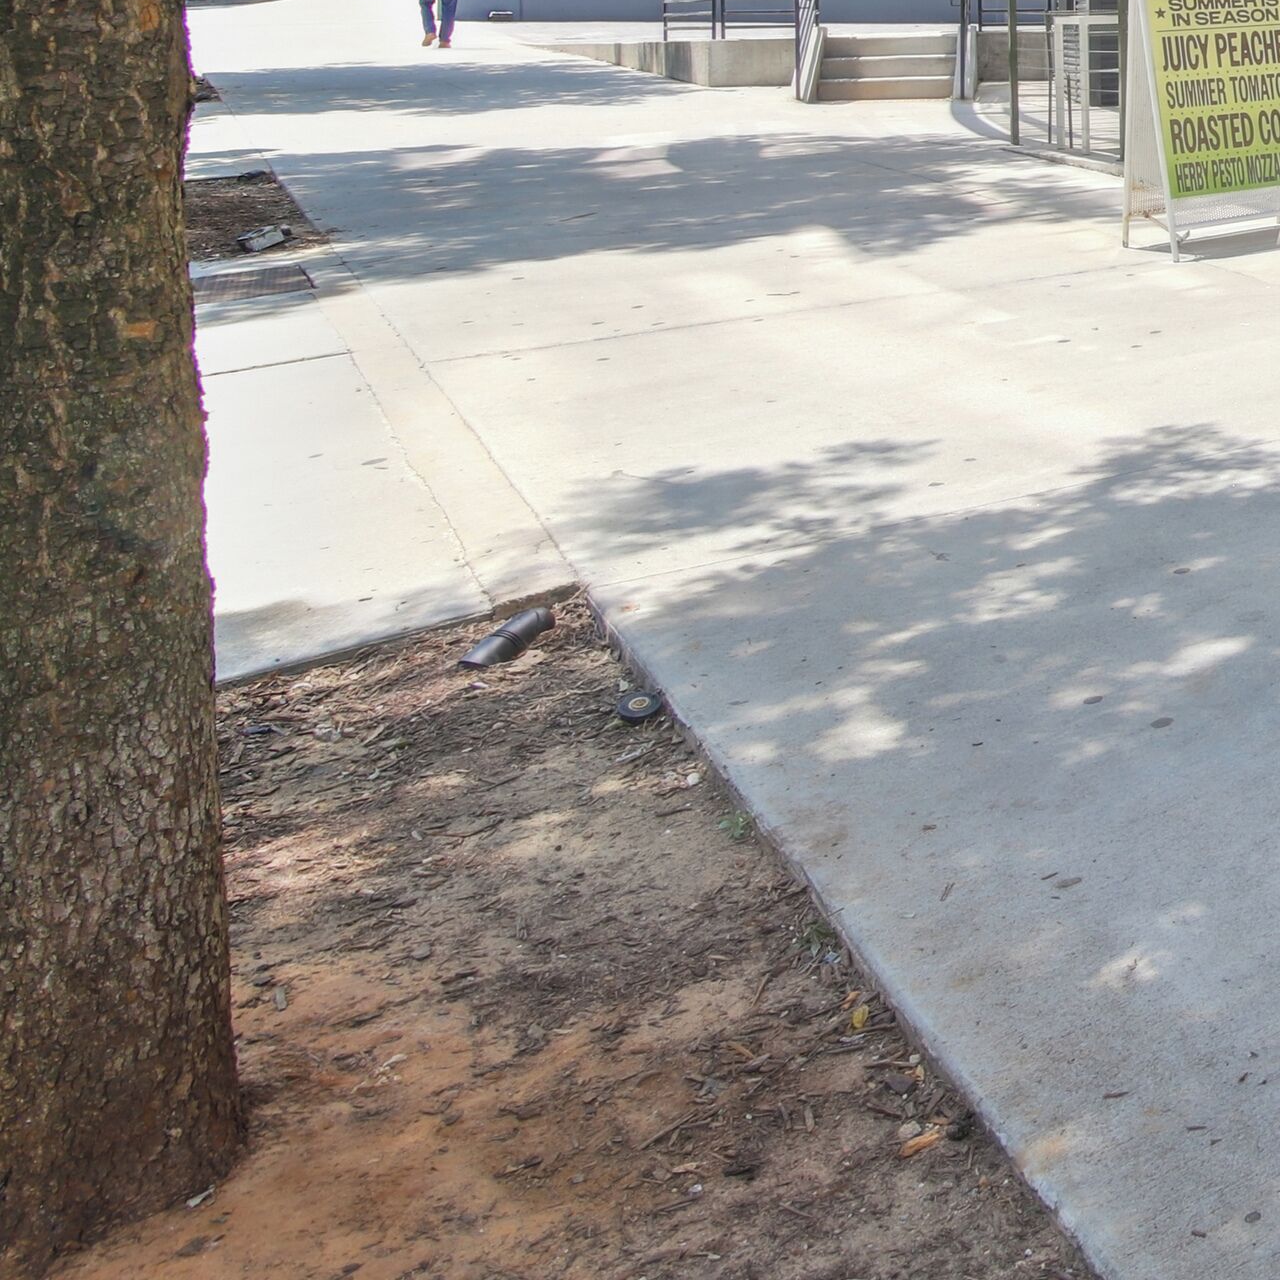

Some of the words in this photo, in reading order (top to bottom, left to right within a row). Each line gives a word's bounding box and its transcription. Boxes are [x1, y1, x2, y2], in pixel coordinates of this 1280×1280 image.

[1172, 12, 1191, 27] IN
[1195, 8, 1279, 25] SEASON
[1162, 34, 1209, 72] JUICY
[1165, 77, 1227, 109] SUMMER
[1169, 112, 1254, 155] ROASTED
[1175, 160, 1209, 193] HERBY
[1211, 156, 1245, 188] PESTO
